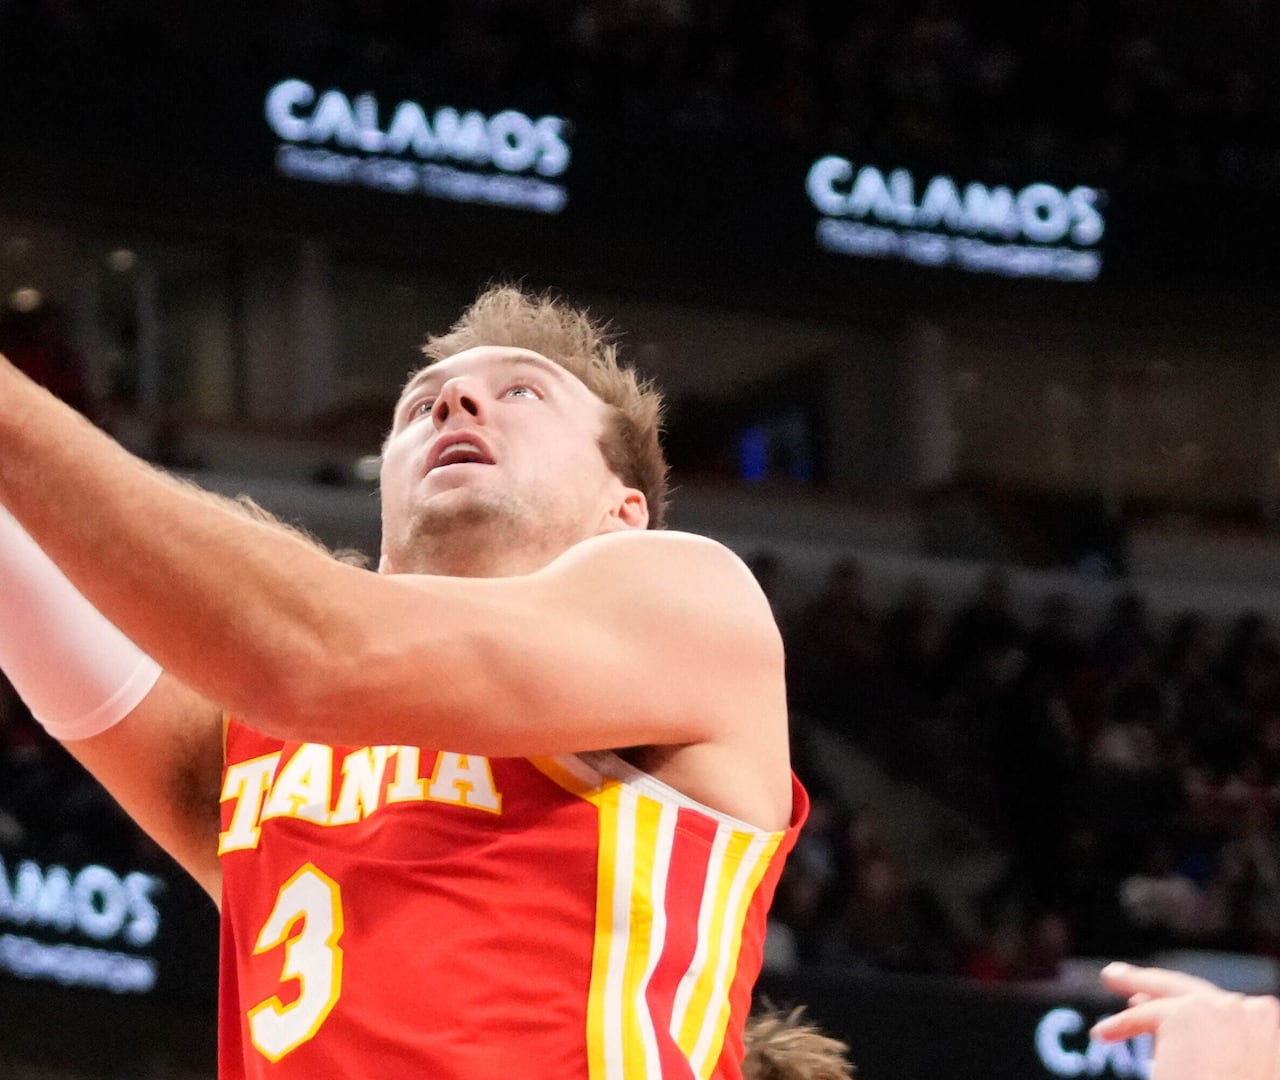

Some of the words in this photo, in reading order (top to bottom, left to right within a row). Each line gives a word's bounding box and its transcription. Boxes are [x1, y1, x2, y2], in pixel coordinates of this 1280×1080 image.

[266, 79, 570, 176] CALAMOS
[805, 155, 1104, 245] CALAMOS
[248, 862, 344, 1063] 3
